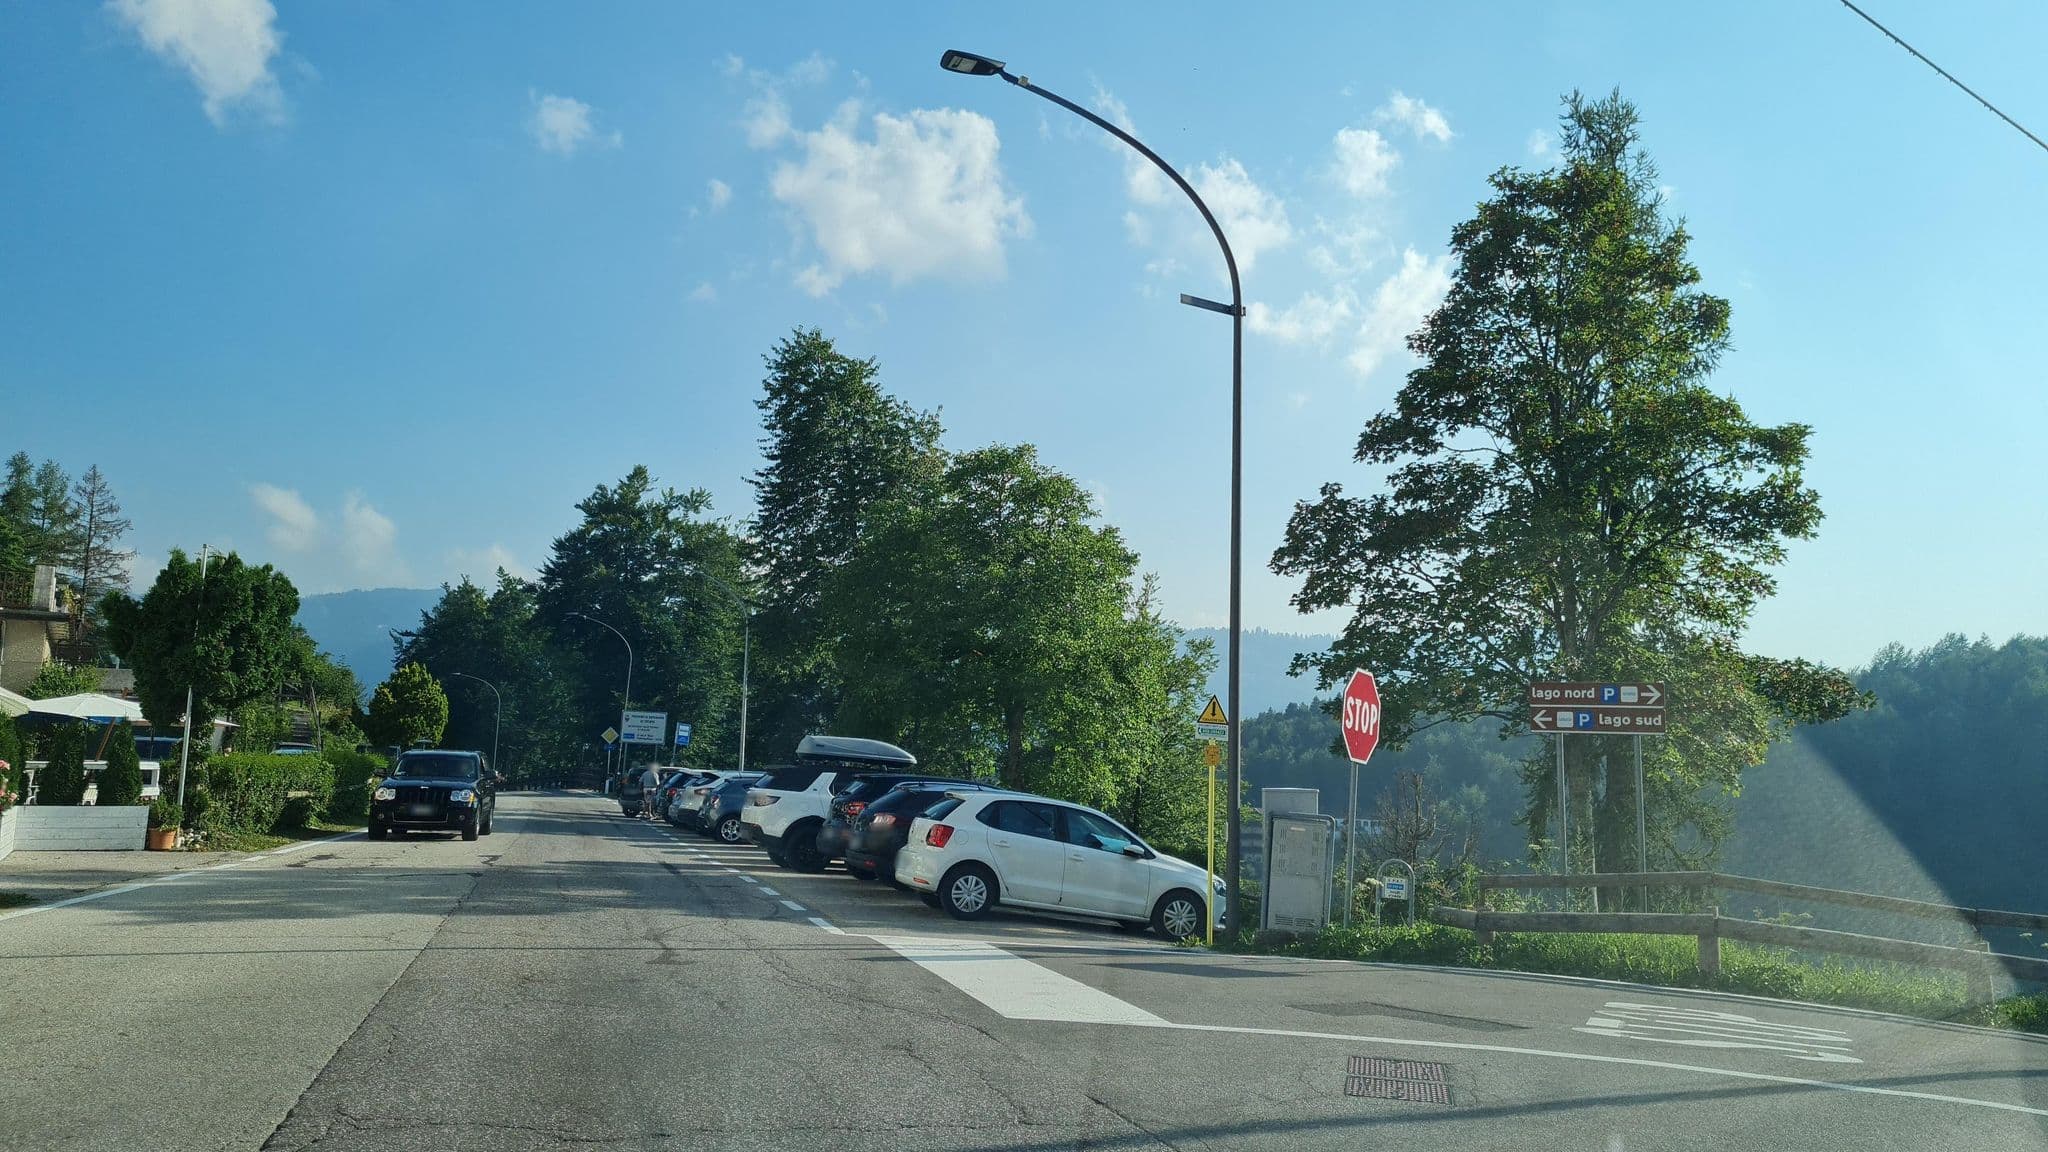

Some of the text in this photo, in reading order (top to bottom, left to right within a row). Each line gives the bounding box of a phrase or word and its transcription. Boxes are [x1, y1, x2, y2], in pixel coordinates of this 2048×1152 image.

[1531, 687, 1615, 701] lago nord P
[1345, 696, 1377, 736] STOP
[1579, 713, 1662, 727] P lago sud
